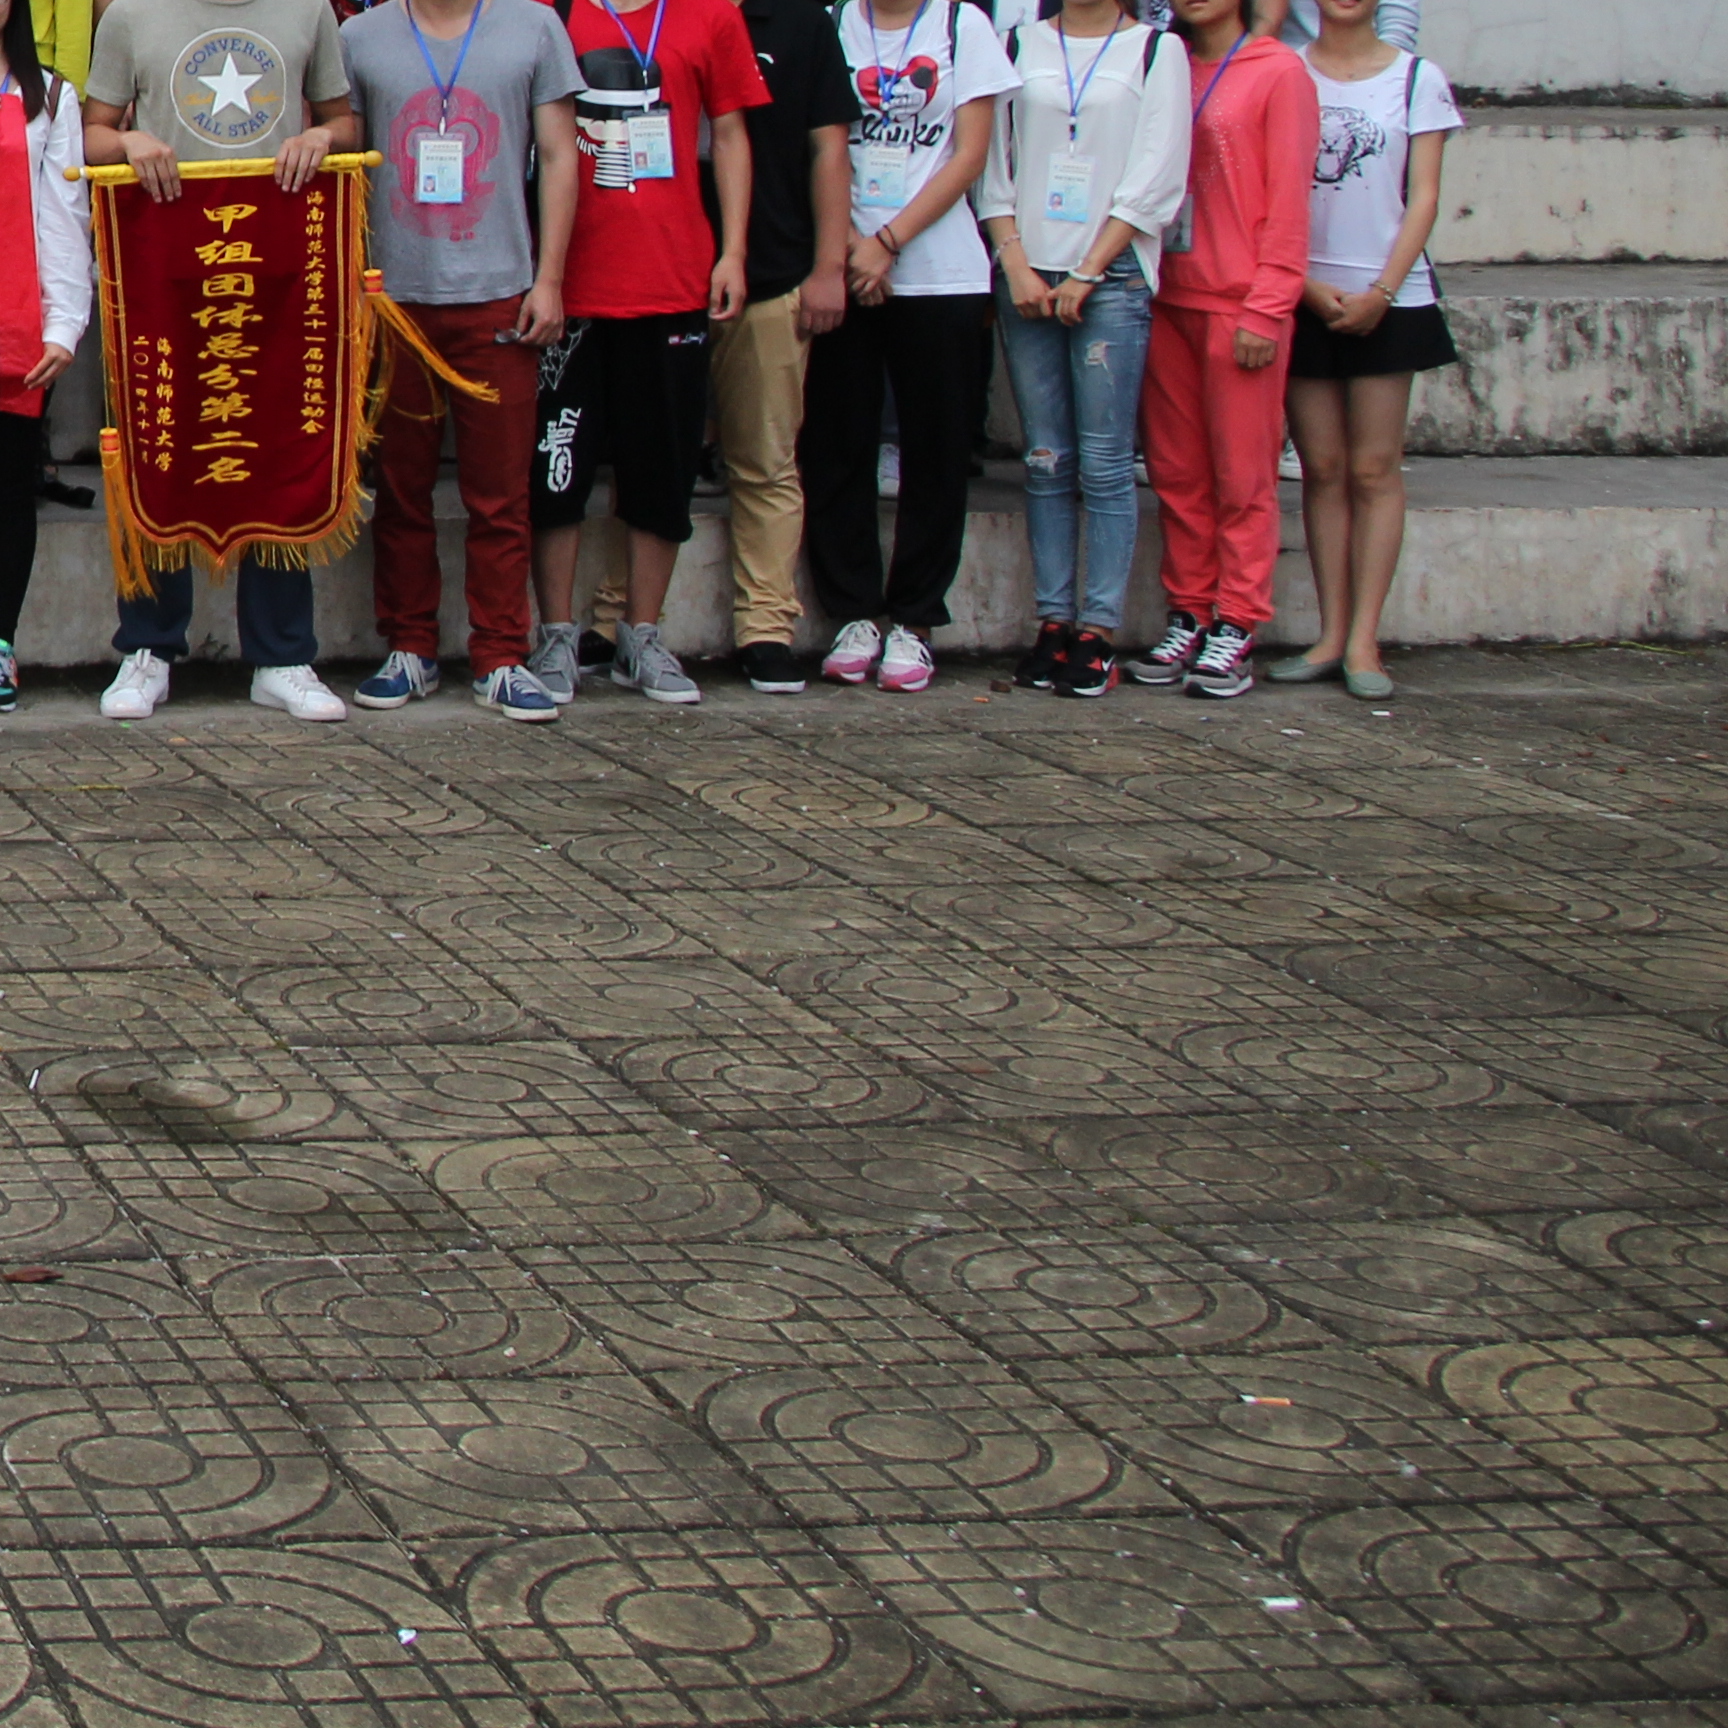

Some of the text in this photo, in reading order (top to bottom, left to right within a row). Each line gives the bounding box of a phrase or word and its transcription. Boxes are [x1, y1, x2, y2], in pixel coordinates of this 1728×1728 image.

[184, 37, 275, 76] CONVERSE
[192, 109, 270, 138] ALL STAR
[190, 202, 264, 485] 甲组团体总分第二名
